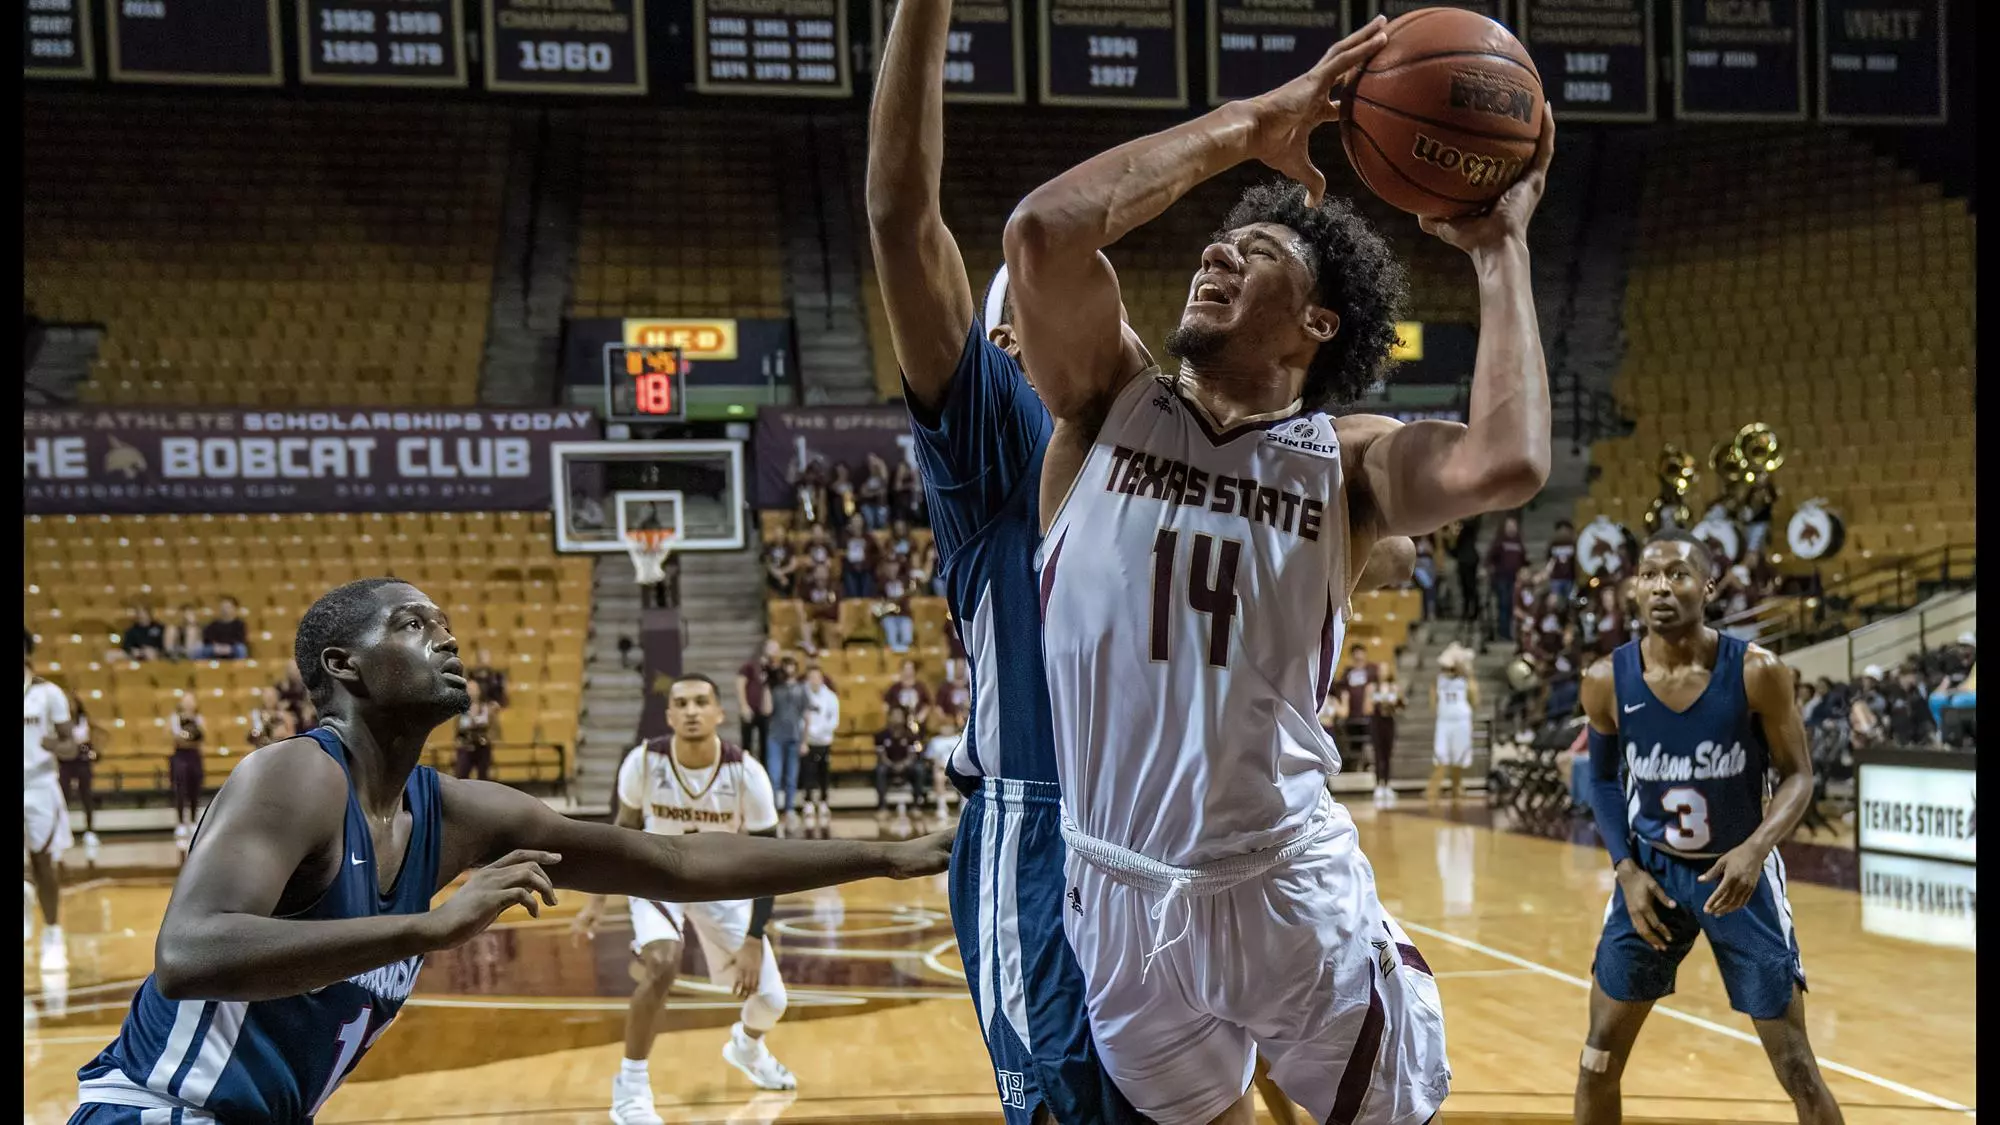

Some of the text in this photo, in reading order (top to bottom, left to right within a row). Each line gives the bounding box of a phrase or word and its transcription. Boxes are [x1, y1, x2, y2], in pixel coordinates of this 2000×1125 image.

[518, 40, 612, 72] 1960
[635, 372, 671, 415] 18
[242, 411, 483, 431] SCHOLARSHIPS
[491, 412, 591, 431] TODAY
[161, 437, 377, 479] BOBCAT
[397, 437, 531, 479] CLUB
[1266, 432, 1338, 455] SUN BELT
[1105, 444, 1324, 542] TEXAS STATE
[1149, 527, 1244, 671] 14
[1694, 739, 1747, 780] State
[650, 803, 692, 822] TEXAS
[1659, 785, 1712, 851] 3
[1862, 800, 1965, 840] TEXAS STATE
